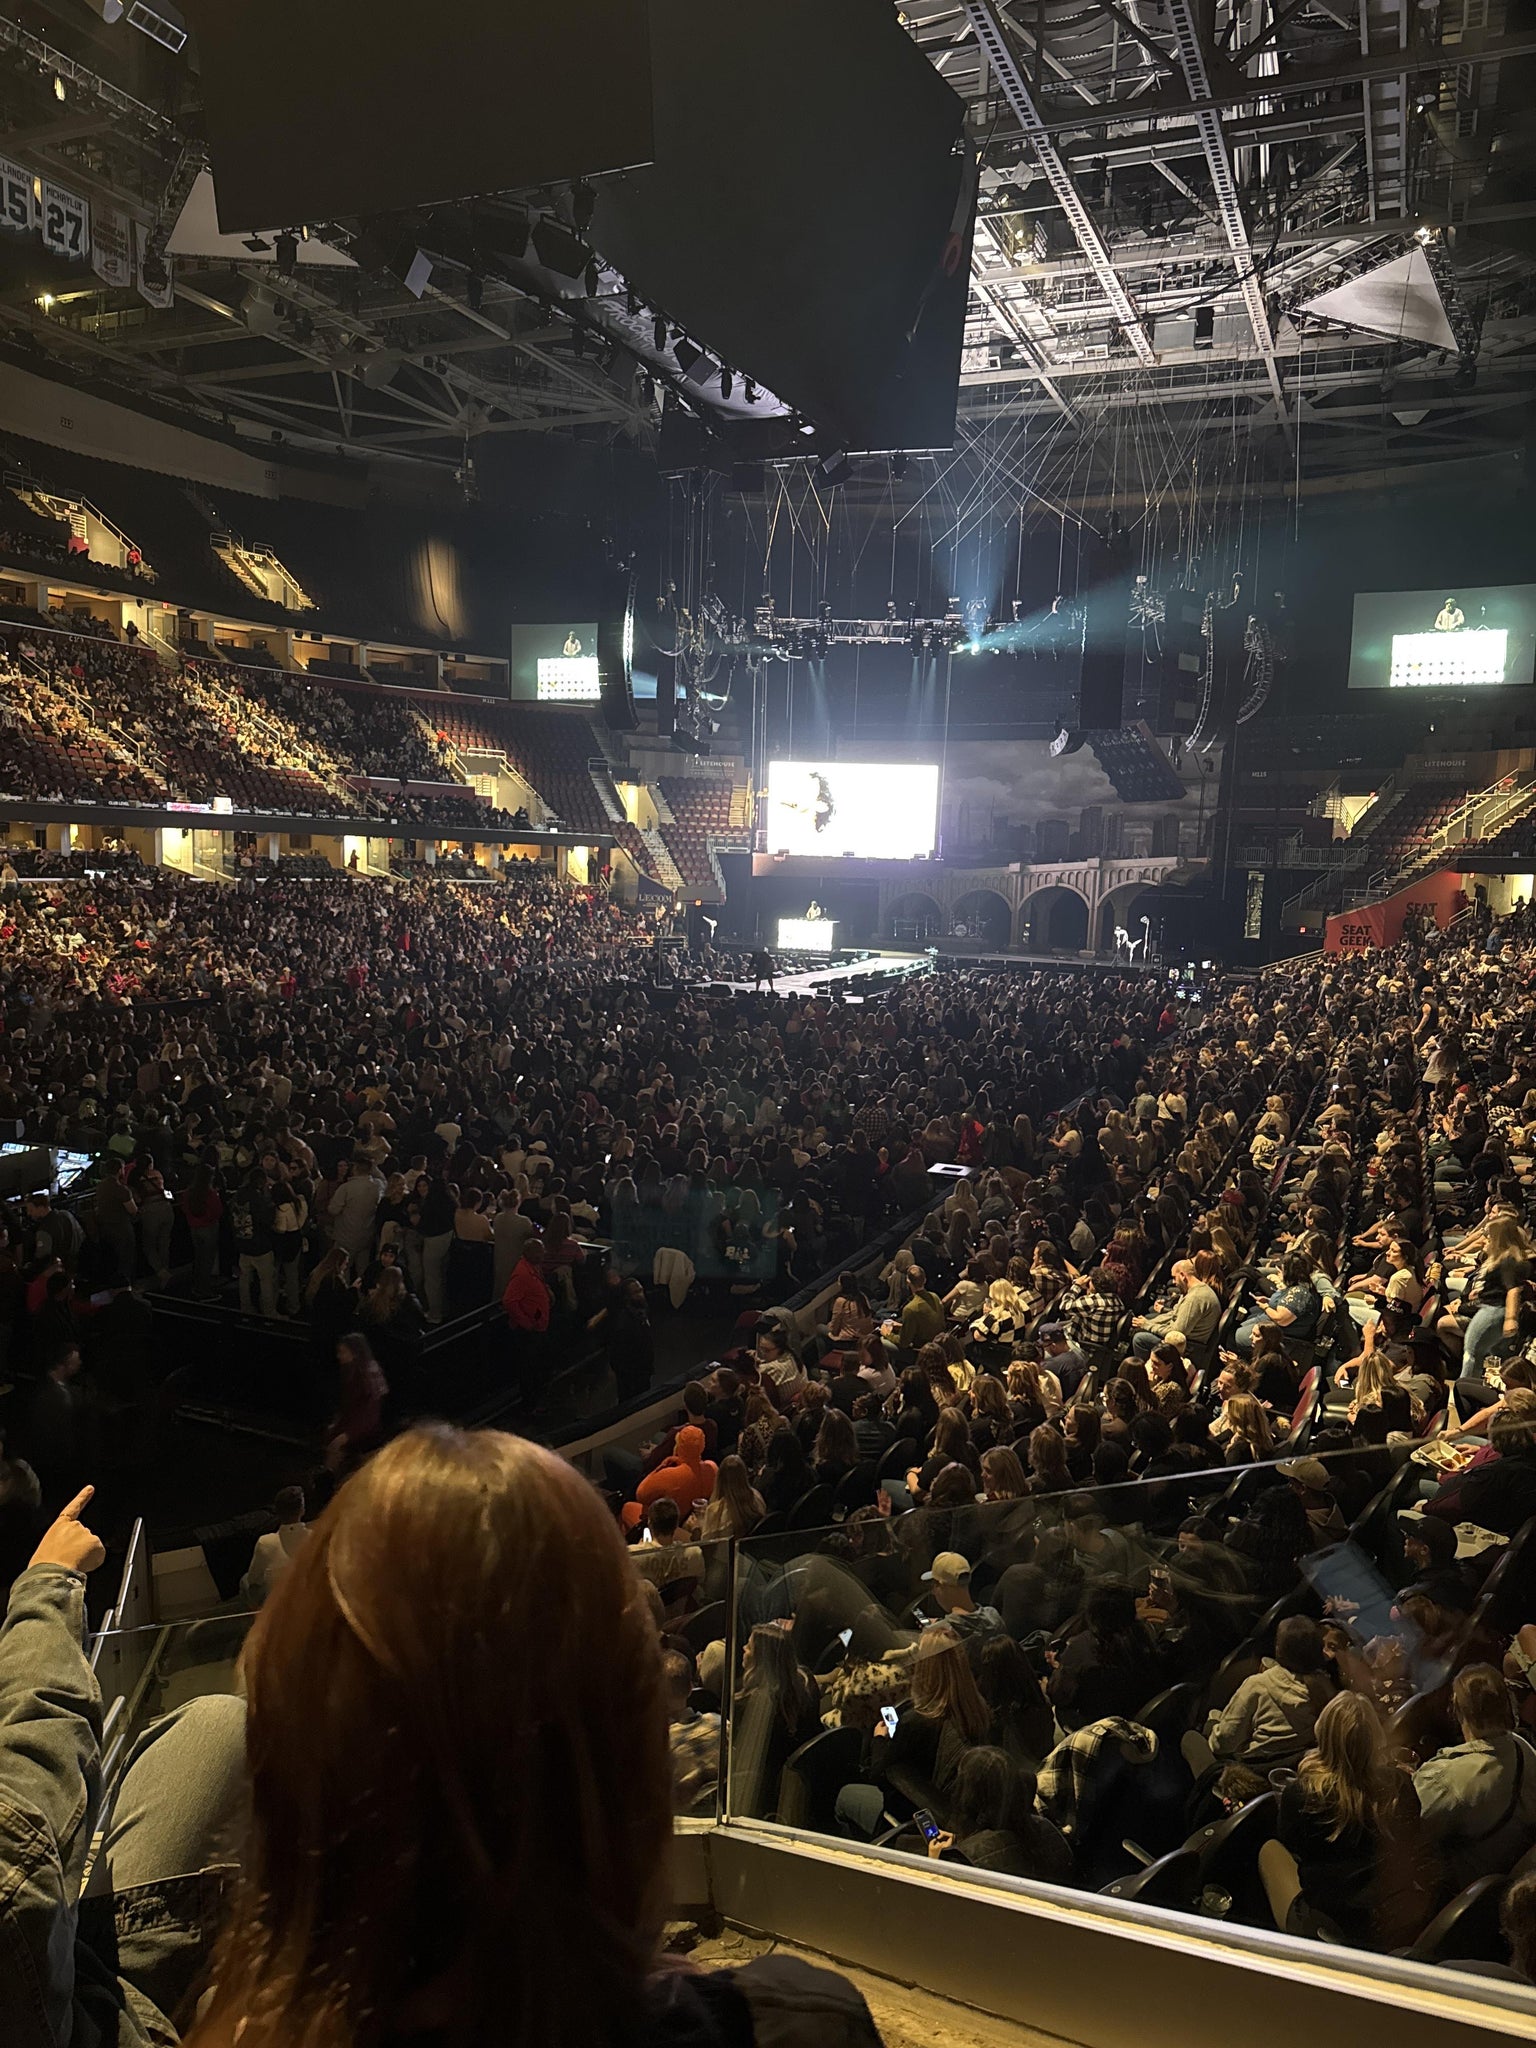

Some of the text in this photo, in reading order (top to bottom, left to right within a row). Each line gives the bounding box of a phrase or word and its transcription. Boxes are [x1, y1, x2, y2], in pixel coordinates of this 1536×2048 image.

[0, 165, 31, 185] LANDER
[47, 203, 82, 251] 27
[639, 893, 672, 903] LECOM
[1406, 902, 1438, 916] SEAT
[1342, 924, 1373, 936] SEAT
[1340, 936, 1372, 947] GEEK
